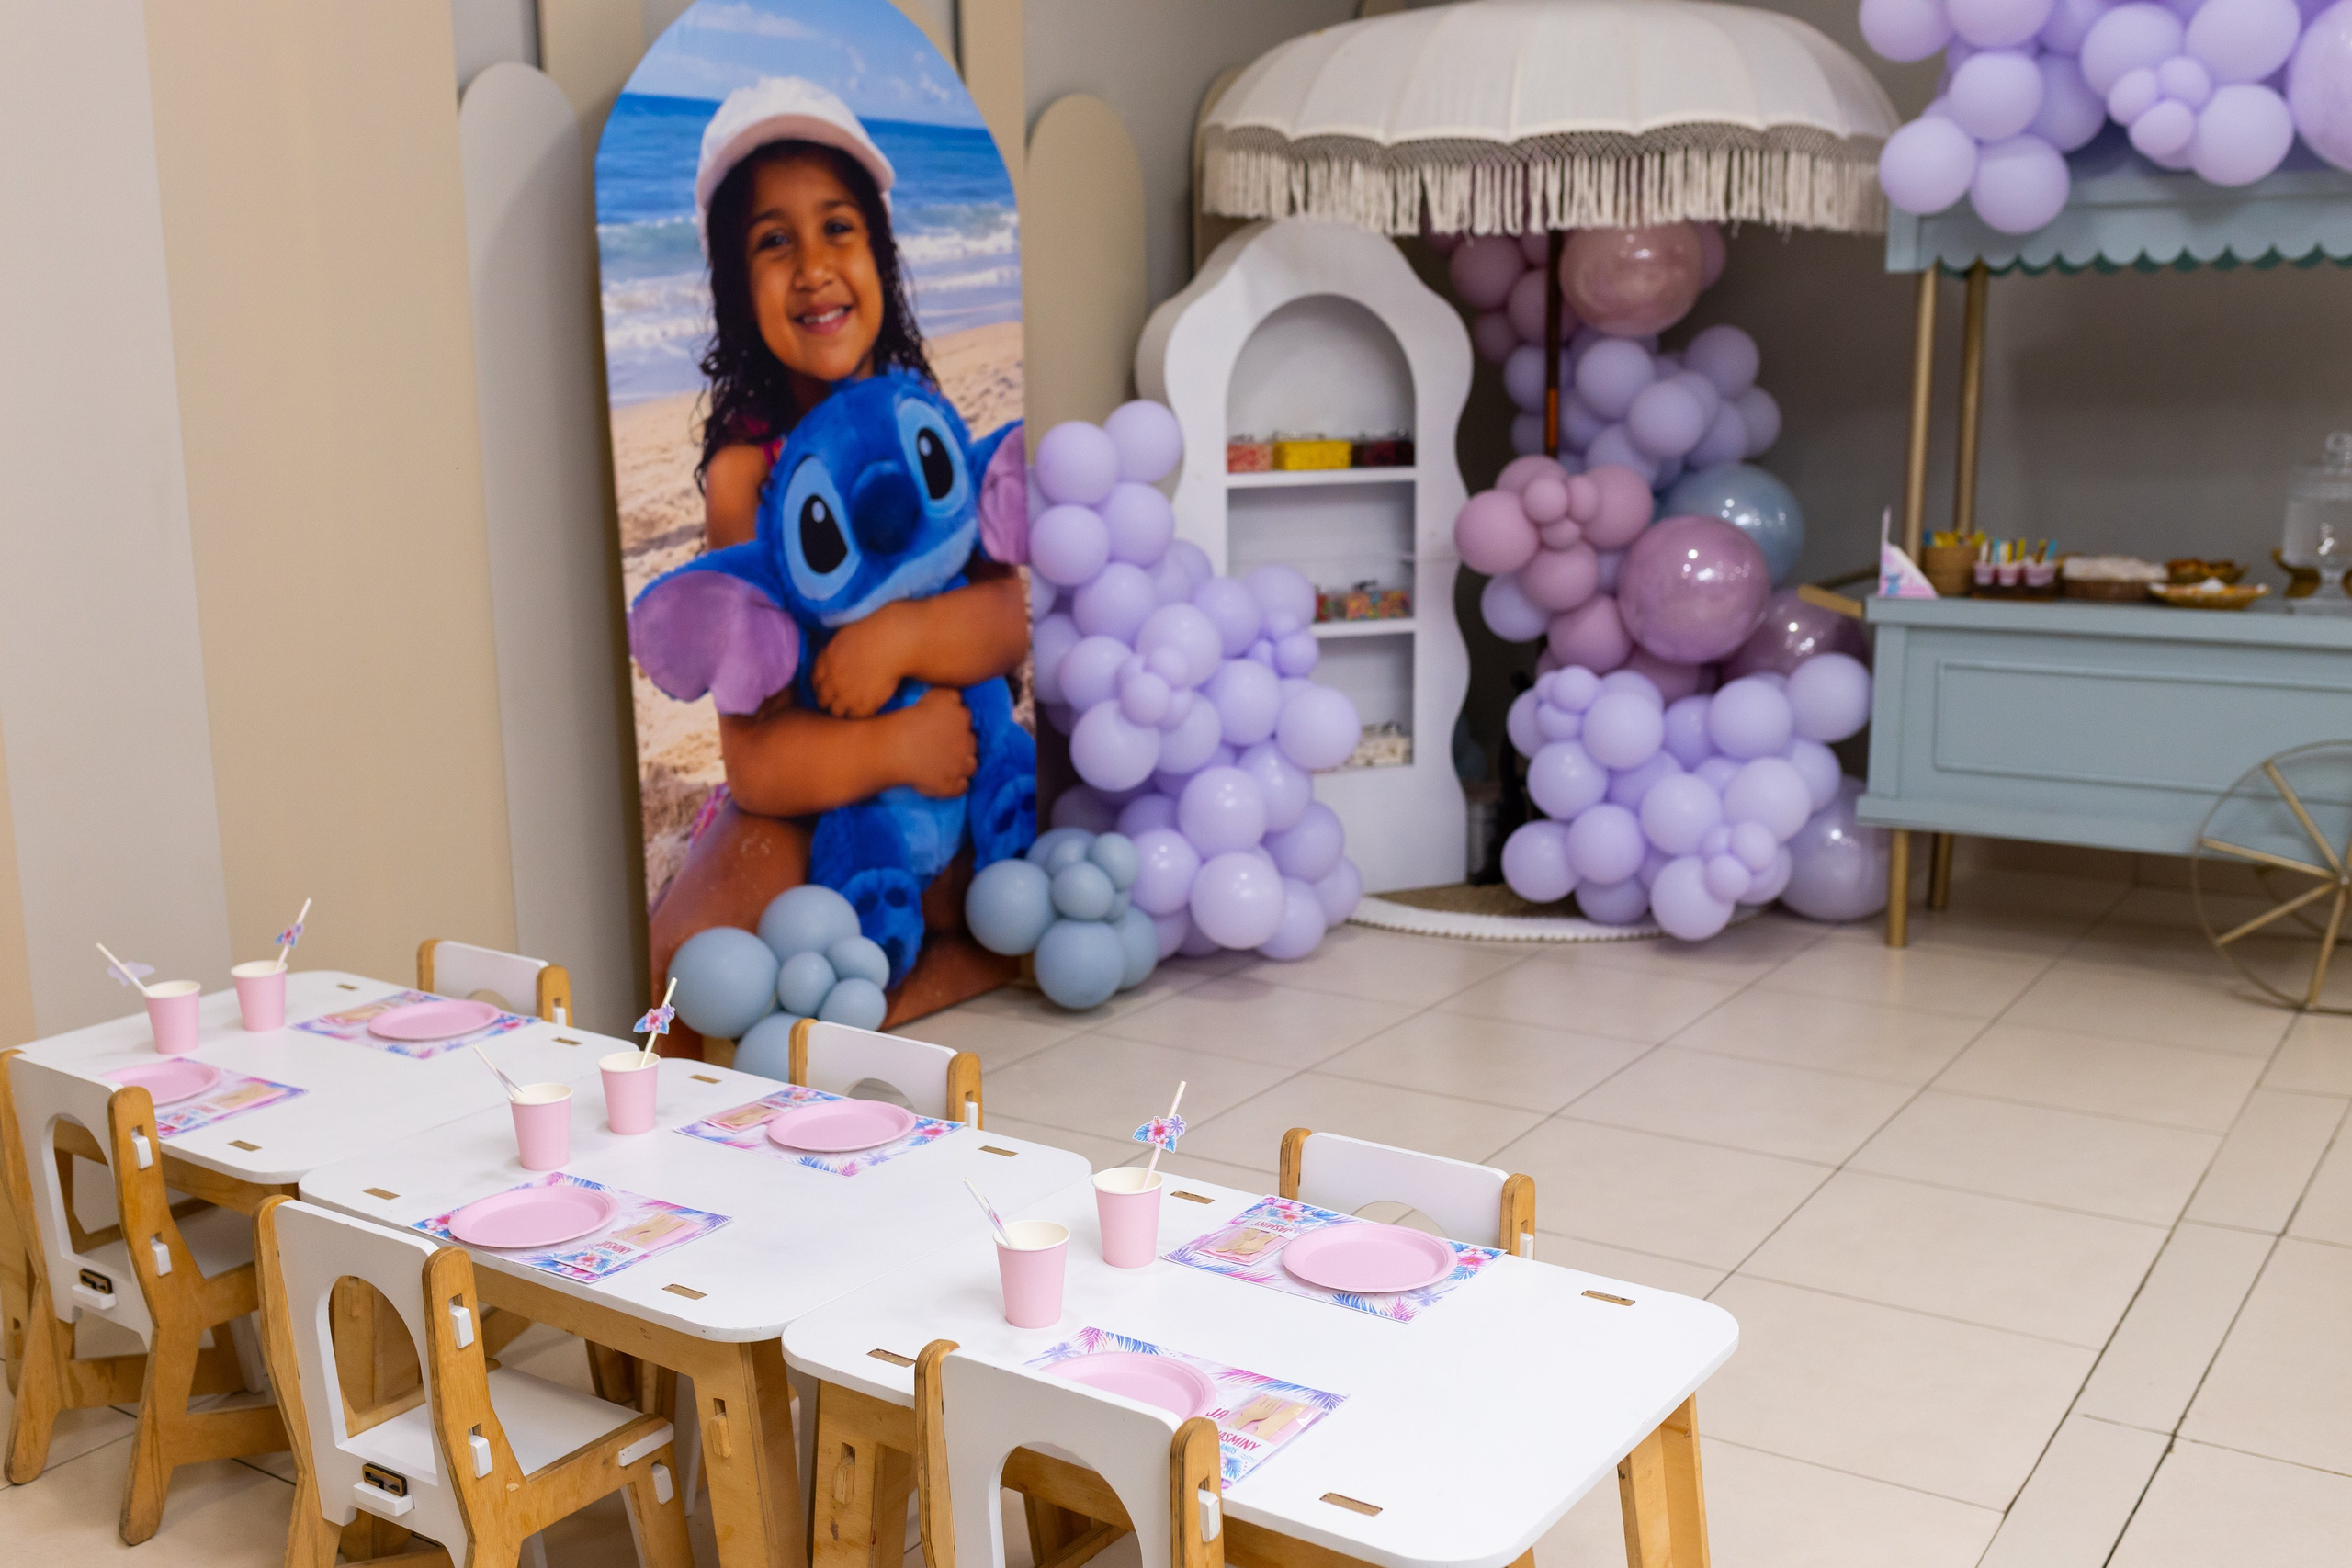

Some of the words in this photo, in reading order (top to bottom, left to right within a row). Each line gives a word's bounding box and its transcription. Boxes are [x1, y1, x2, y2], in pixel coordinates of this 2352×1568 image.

[1250, 1221, 1293, 1233] JASMINY
[595, 1240, 635, 1255] JASMINY
[1218, 1430, 1261, 1452] ASMINY
